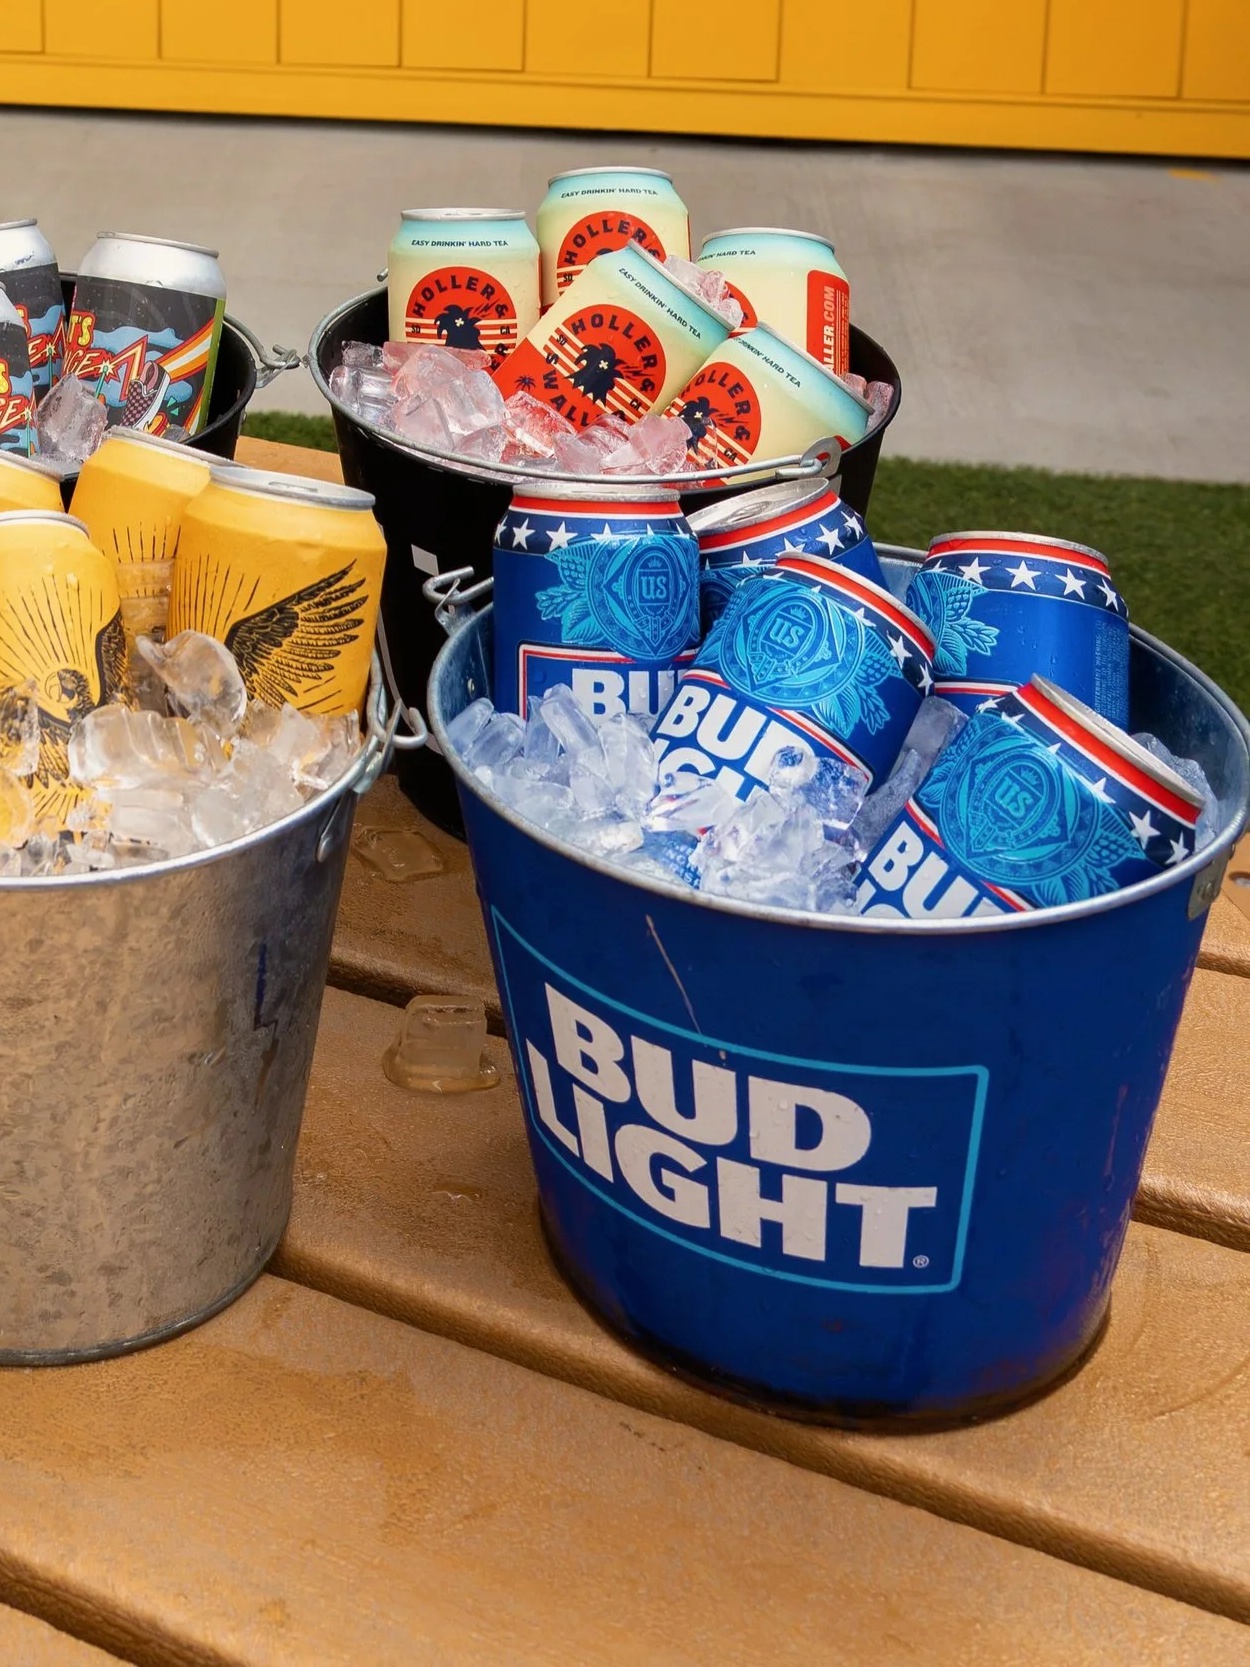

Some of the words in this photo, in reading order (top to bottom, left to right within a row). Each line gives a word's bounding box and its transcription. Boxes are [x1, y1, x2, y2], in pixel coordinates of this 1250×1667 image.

[561, 190, 579, 199] EASY
[580, 187, 617, 196] DRINKIN'
[618, 187, 642, 195] HARD
[411, 239, 430, 247] EASY
[430, 239, 467, 247] DRINKIN'
[468, 239, 492, 247] HARD
[493, 239, 509, 247] TEA
[563, 218, 647, 266] HOLLER
[716, 250, 738, 258] HARD
[412, 274, 496, 318] HOLLER
[494, 302, 509, 318] &
[618, 267, 636, 284] EASY
[634, 281, 668, 309] DRINKIN'
[666, 304, 689, 329] HARD
[688, 323, 702, 340] TEA
[570, 313, 658, 370] HOLLER
[822, 285, 836, 371] ALLER.COM
[762, 355, 785, 375] HARD
[785, 370, 801, 388] TEA
[572, 668, 688, 730] BU
[867, 820, 1007, 919] BU
[544, 982, 872, 1172] BUD
[525, 1038, 938, 1269] LIGHT
